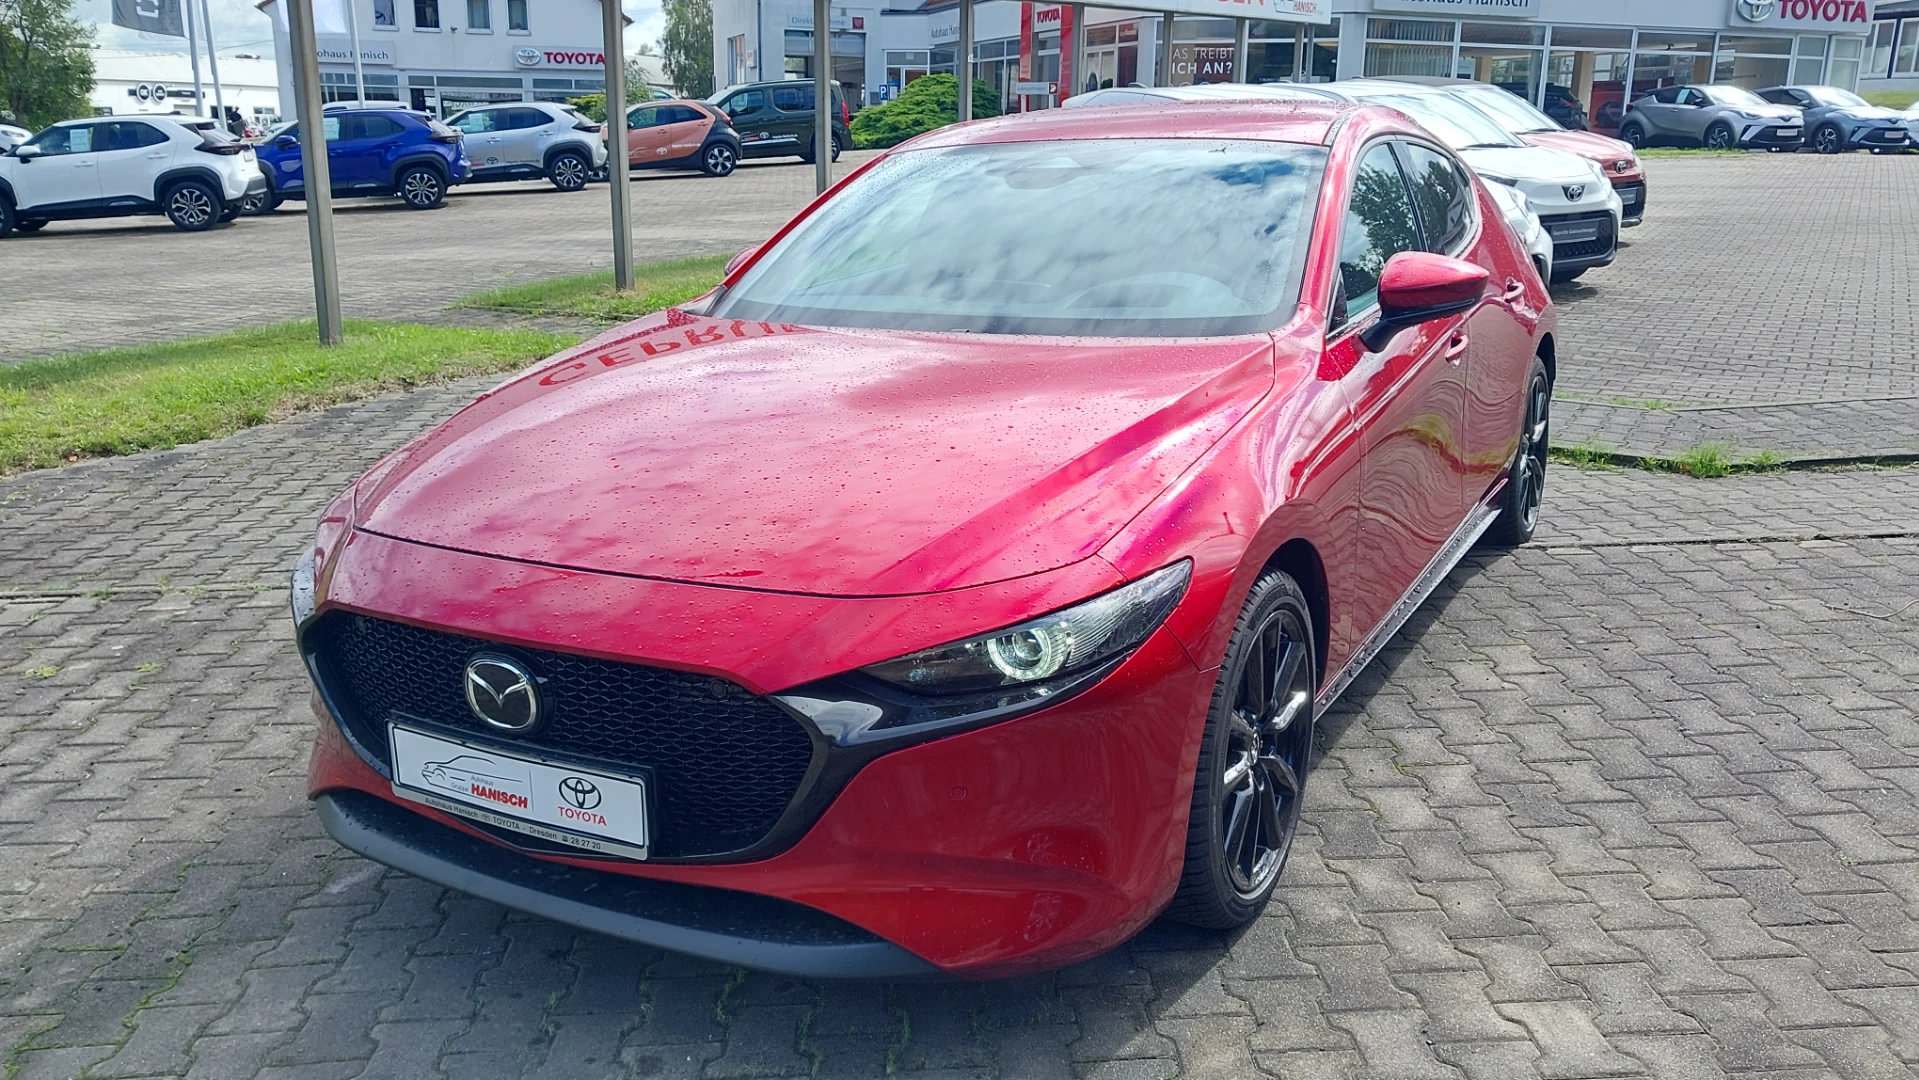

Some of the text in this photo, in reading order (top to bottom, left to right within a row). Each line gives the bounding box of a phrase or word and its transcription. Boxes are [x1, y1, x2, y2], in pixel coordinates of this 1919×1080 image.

[1779, 0, 1867, 22] TOYOTA
[317, 49, 347, 58] ohaus
[543, 52, 605, 65] TOYOTA
[1173, 47, 1235, 60] AS TREIBT
[1172, 62, 1233, 74] ICH AN?
[471, 783, 529, 809] HANISCH
[557, 806, 607, 826] TOYOTA
[492, 815, 520, 830] TOYOTA
[529, 825, 557, 841] Dresden
